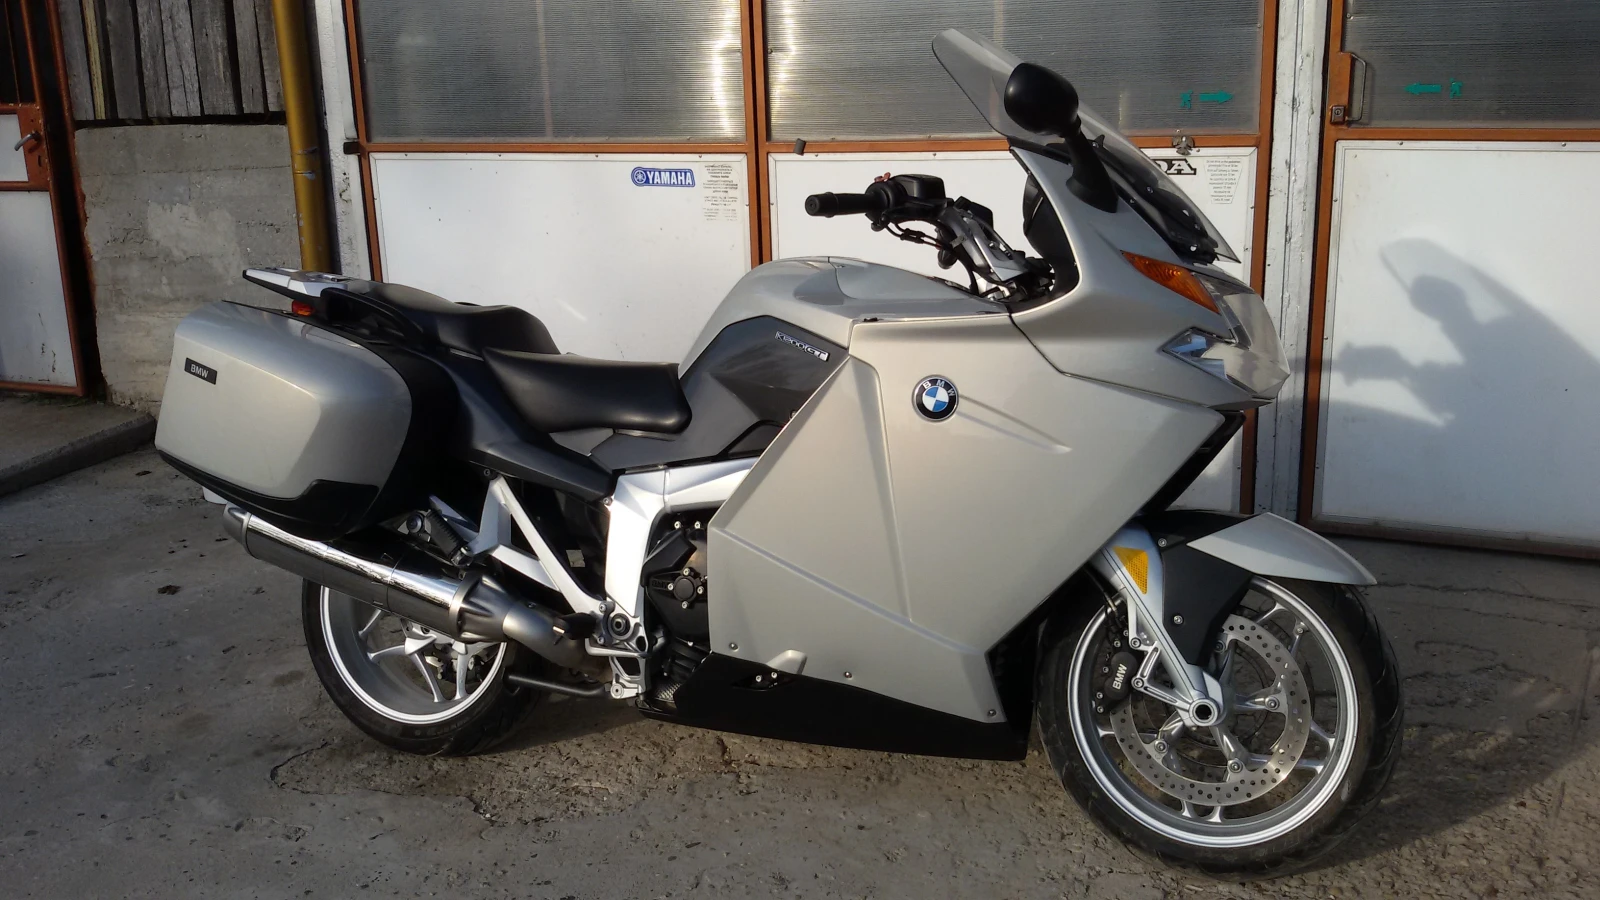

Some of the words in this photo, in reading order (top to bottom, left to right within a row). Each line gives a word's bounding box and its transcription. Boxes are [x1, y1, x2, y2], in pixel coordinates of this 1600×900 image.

[646, 171, 693, 186] YAMAHA
[190, 363, 209, 379] BMW
[922, 379, 956, 397] BMW
[1112, 663, 1127, 690] BMW
